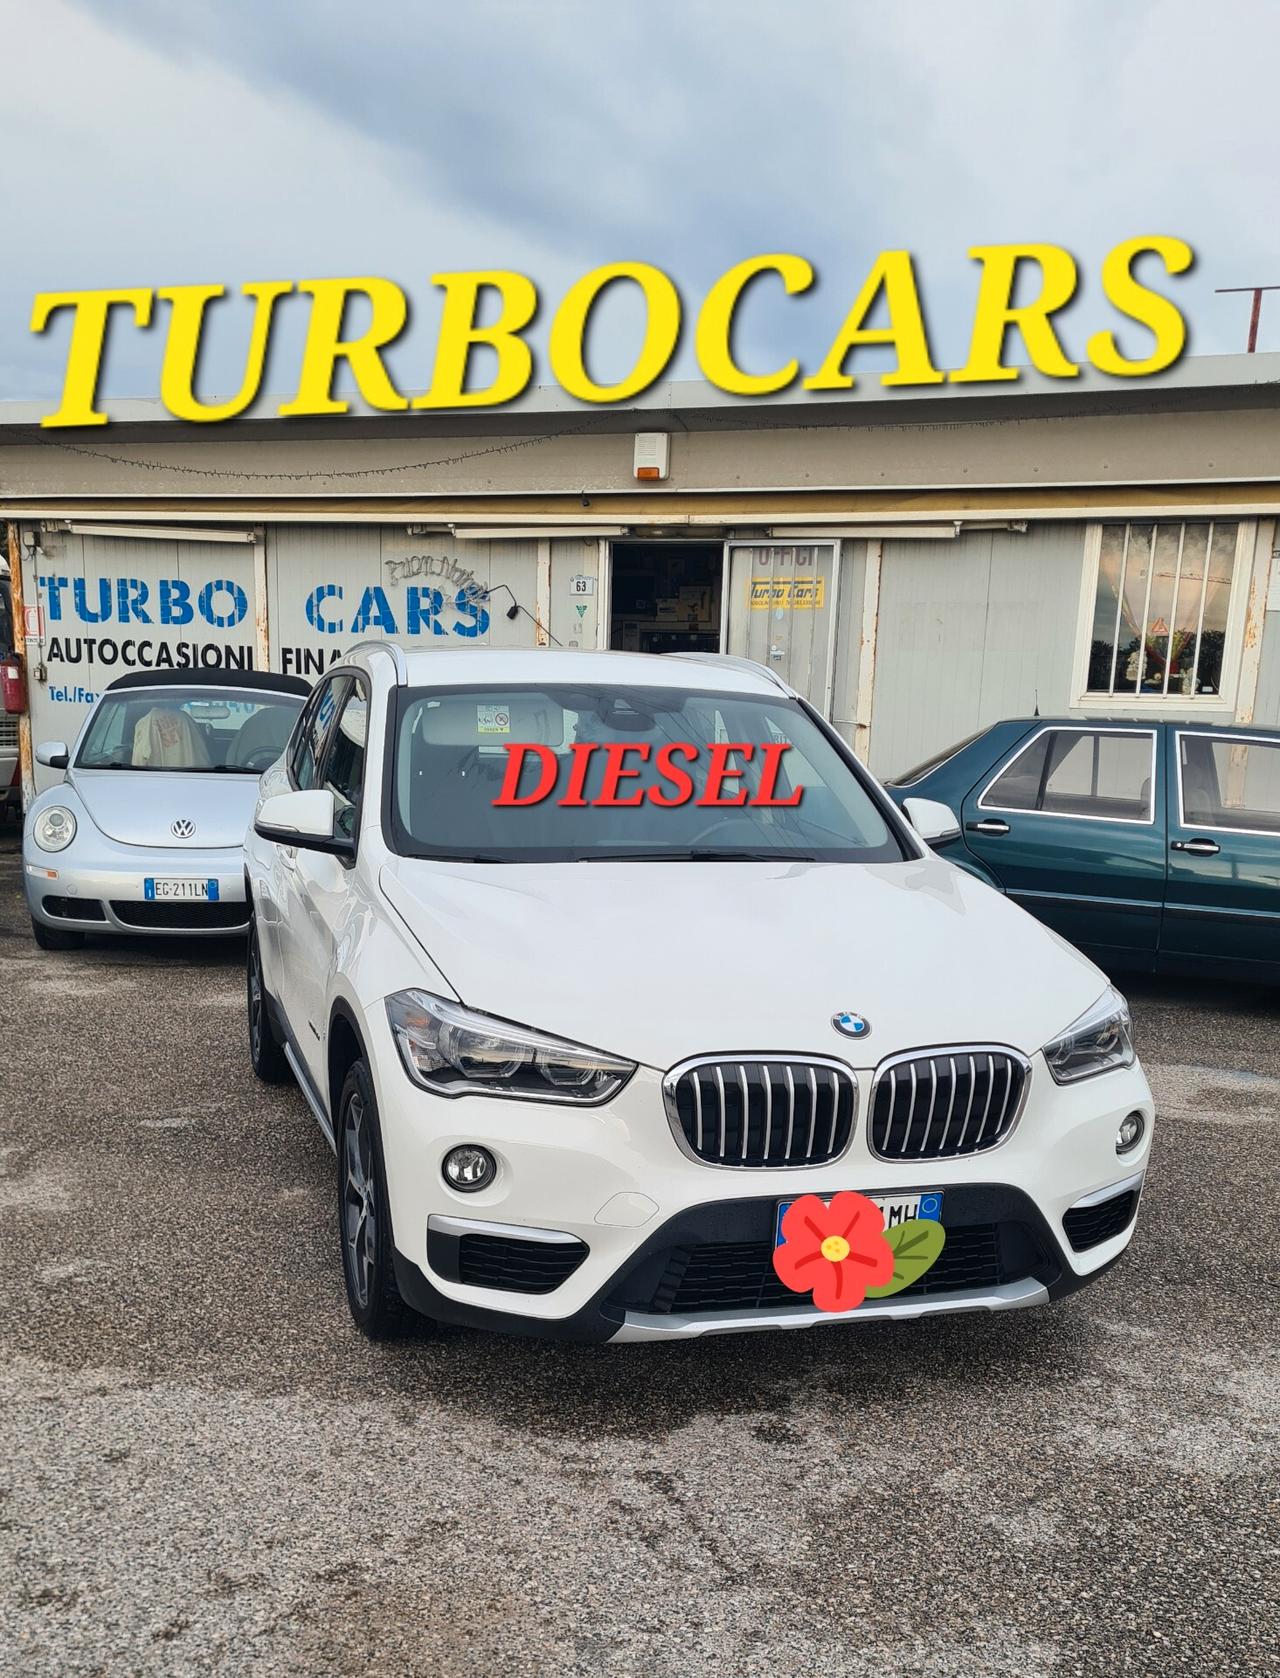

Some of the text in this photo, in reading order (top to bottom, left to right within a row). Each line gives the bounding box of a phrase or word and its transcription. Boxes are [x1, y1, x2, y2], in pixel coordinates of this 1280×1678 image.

[576, 581, 587, 592] 63
[40, 577, 490, 637] TURBO CARS
[47, 637, 253, 671] AUTOCCASIONI
